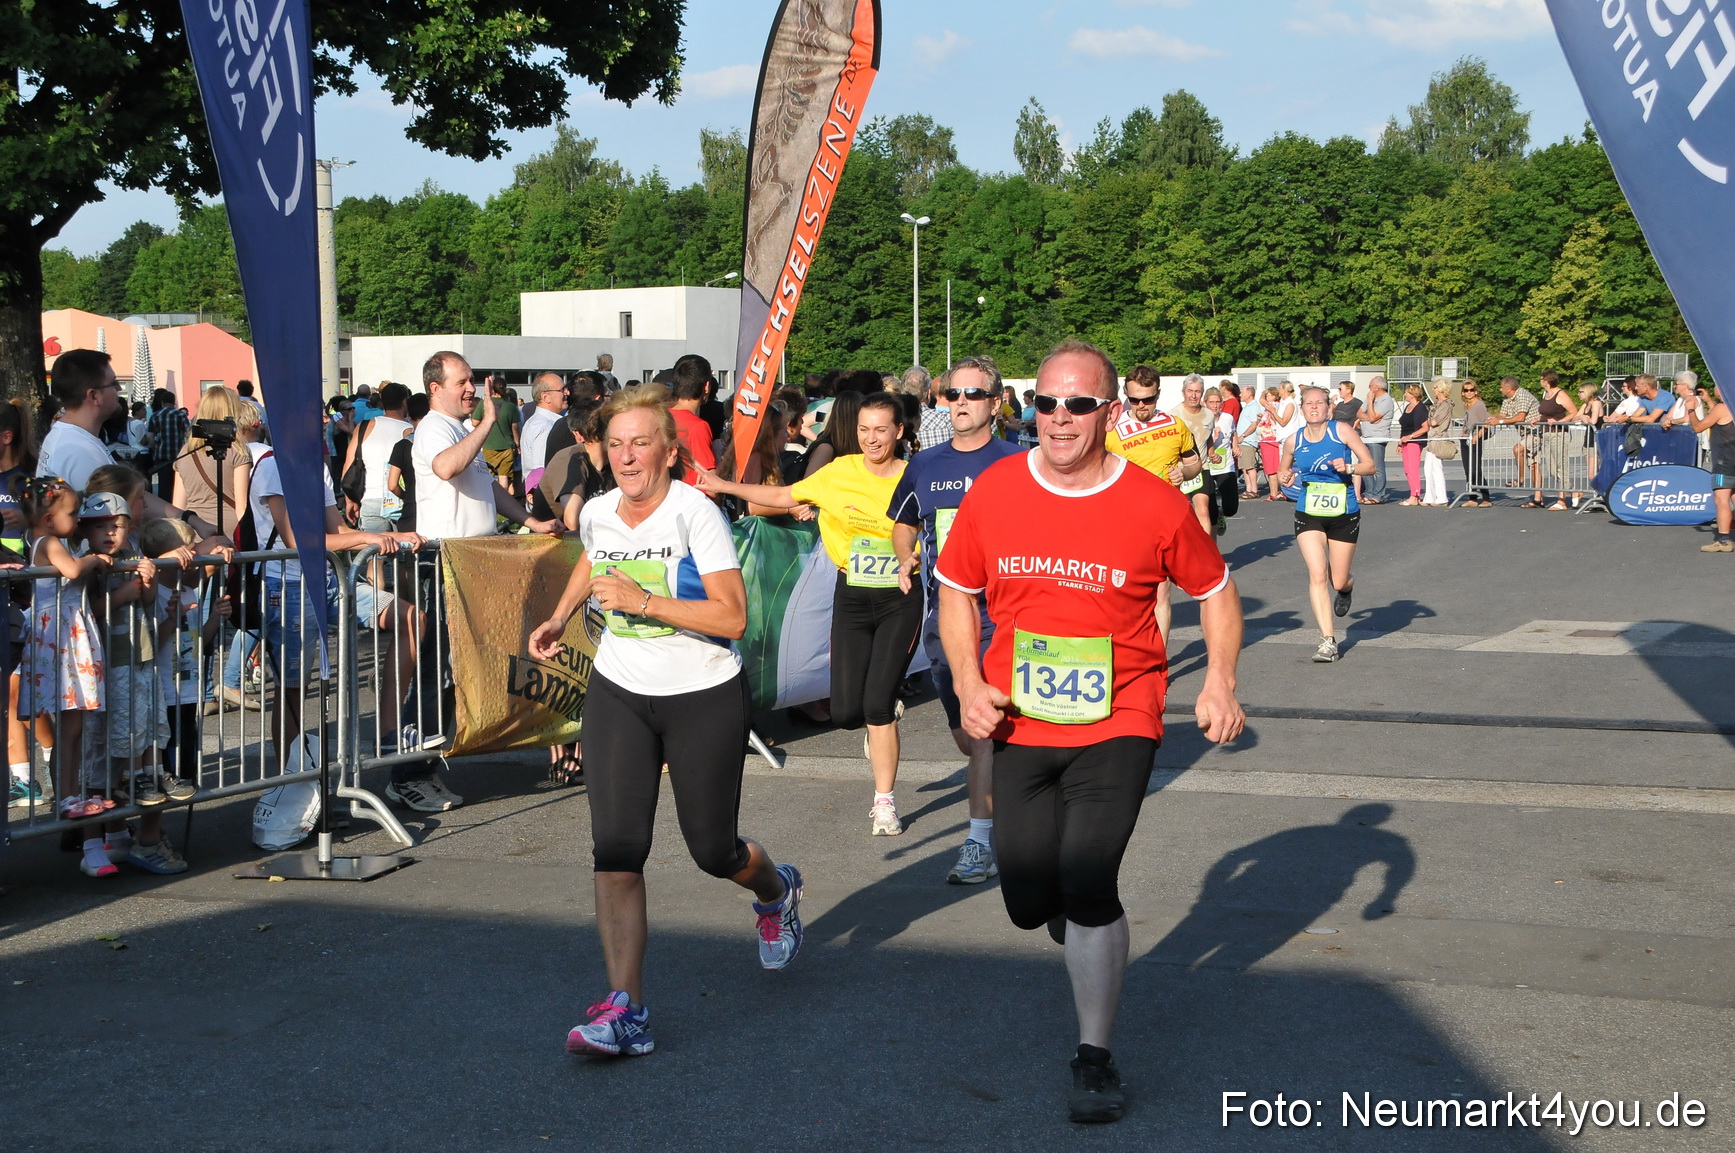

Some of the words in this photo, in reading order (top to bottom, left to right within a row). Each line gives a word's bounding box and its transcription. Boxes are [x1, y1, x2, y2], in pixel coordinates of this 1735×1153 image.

[1123, 436, 1149, 451] MAX
[1152, 428, 1180, 441] BÖGL
[930, 480, 963, 492] EURO
[1312, 494, 1339, 509] 750
[1638, 491, 1712, 505] Fischer
[1644, 504, 1706, 512] AUTOMOBILE
[594, 546, 672, 562] DELPHI
[850, 553, 901, 576] 1272
[998, 556, 1108, 582] NEUMARKT
[1058, 580, 1083, 590] STARKE
[1084, 584, 1105, 594] STADT
[1016, 661, 1106, 704] 1343
